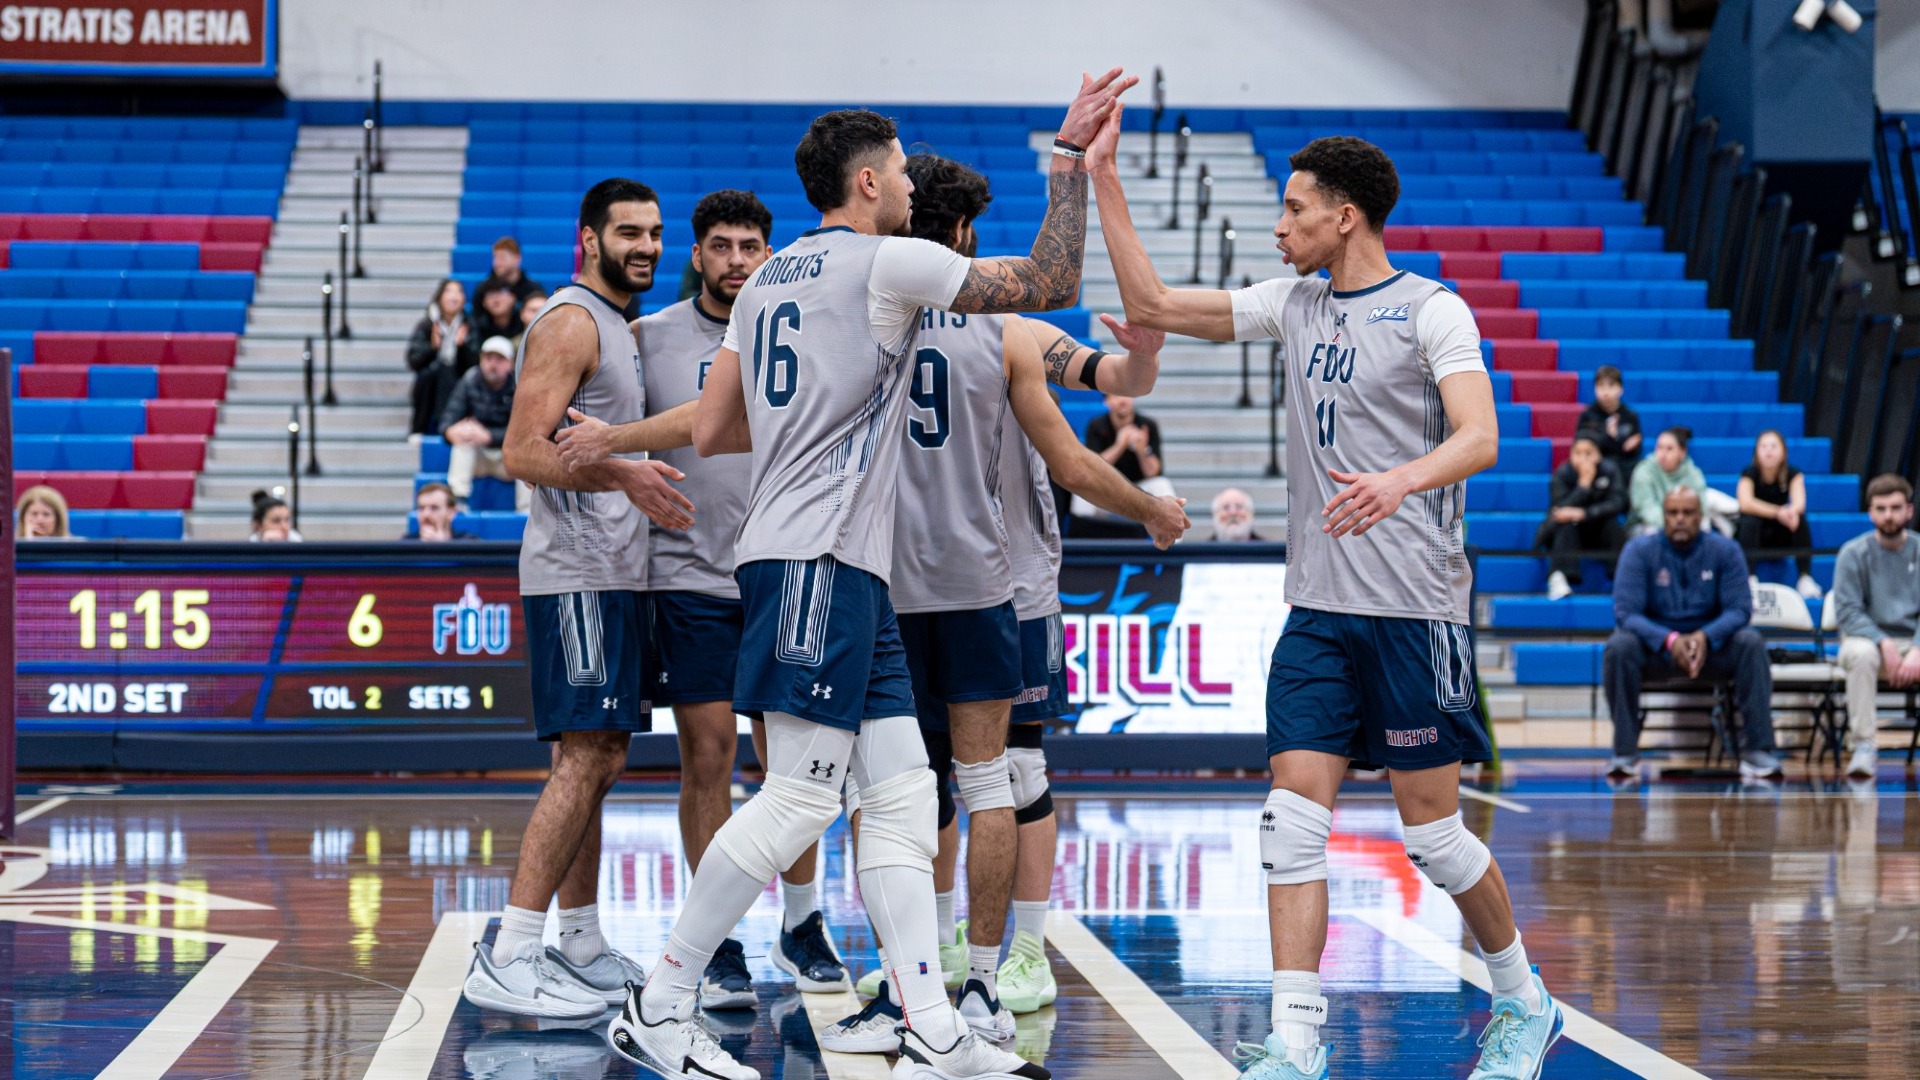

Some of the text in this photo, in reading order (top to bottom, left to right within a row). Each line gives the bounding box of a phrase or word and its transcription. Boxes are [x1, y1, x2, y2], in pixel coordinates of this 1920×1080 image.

[0, 5, 251, 45] STRATIS ARENA
[754, 249, 830, 288] KNIGHTS
[1366, 302, 1411, 322] NEC
[753, 300, 802, 411] 16
[1305, 342, 1357, 385] FDU
[907, 346, 951, 450] 9
[1315, 394, 1338, 449] 11
[69, 589, 211, 650] 1:15
[347, 593, 383, 648] 6
[432, 602, 511, 655] FDU
[48, 683, 189, 713] 2ND SET
[308, 686, 382, 710] TOL 2
[408, 686, 494, 710] SETS 1
[1385, 727, 1438, 747] KNIGHTS
